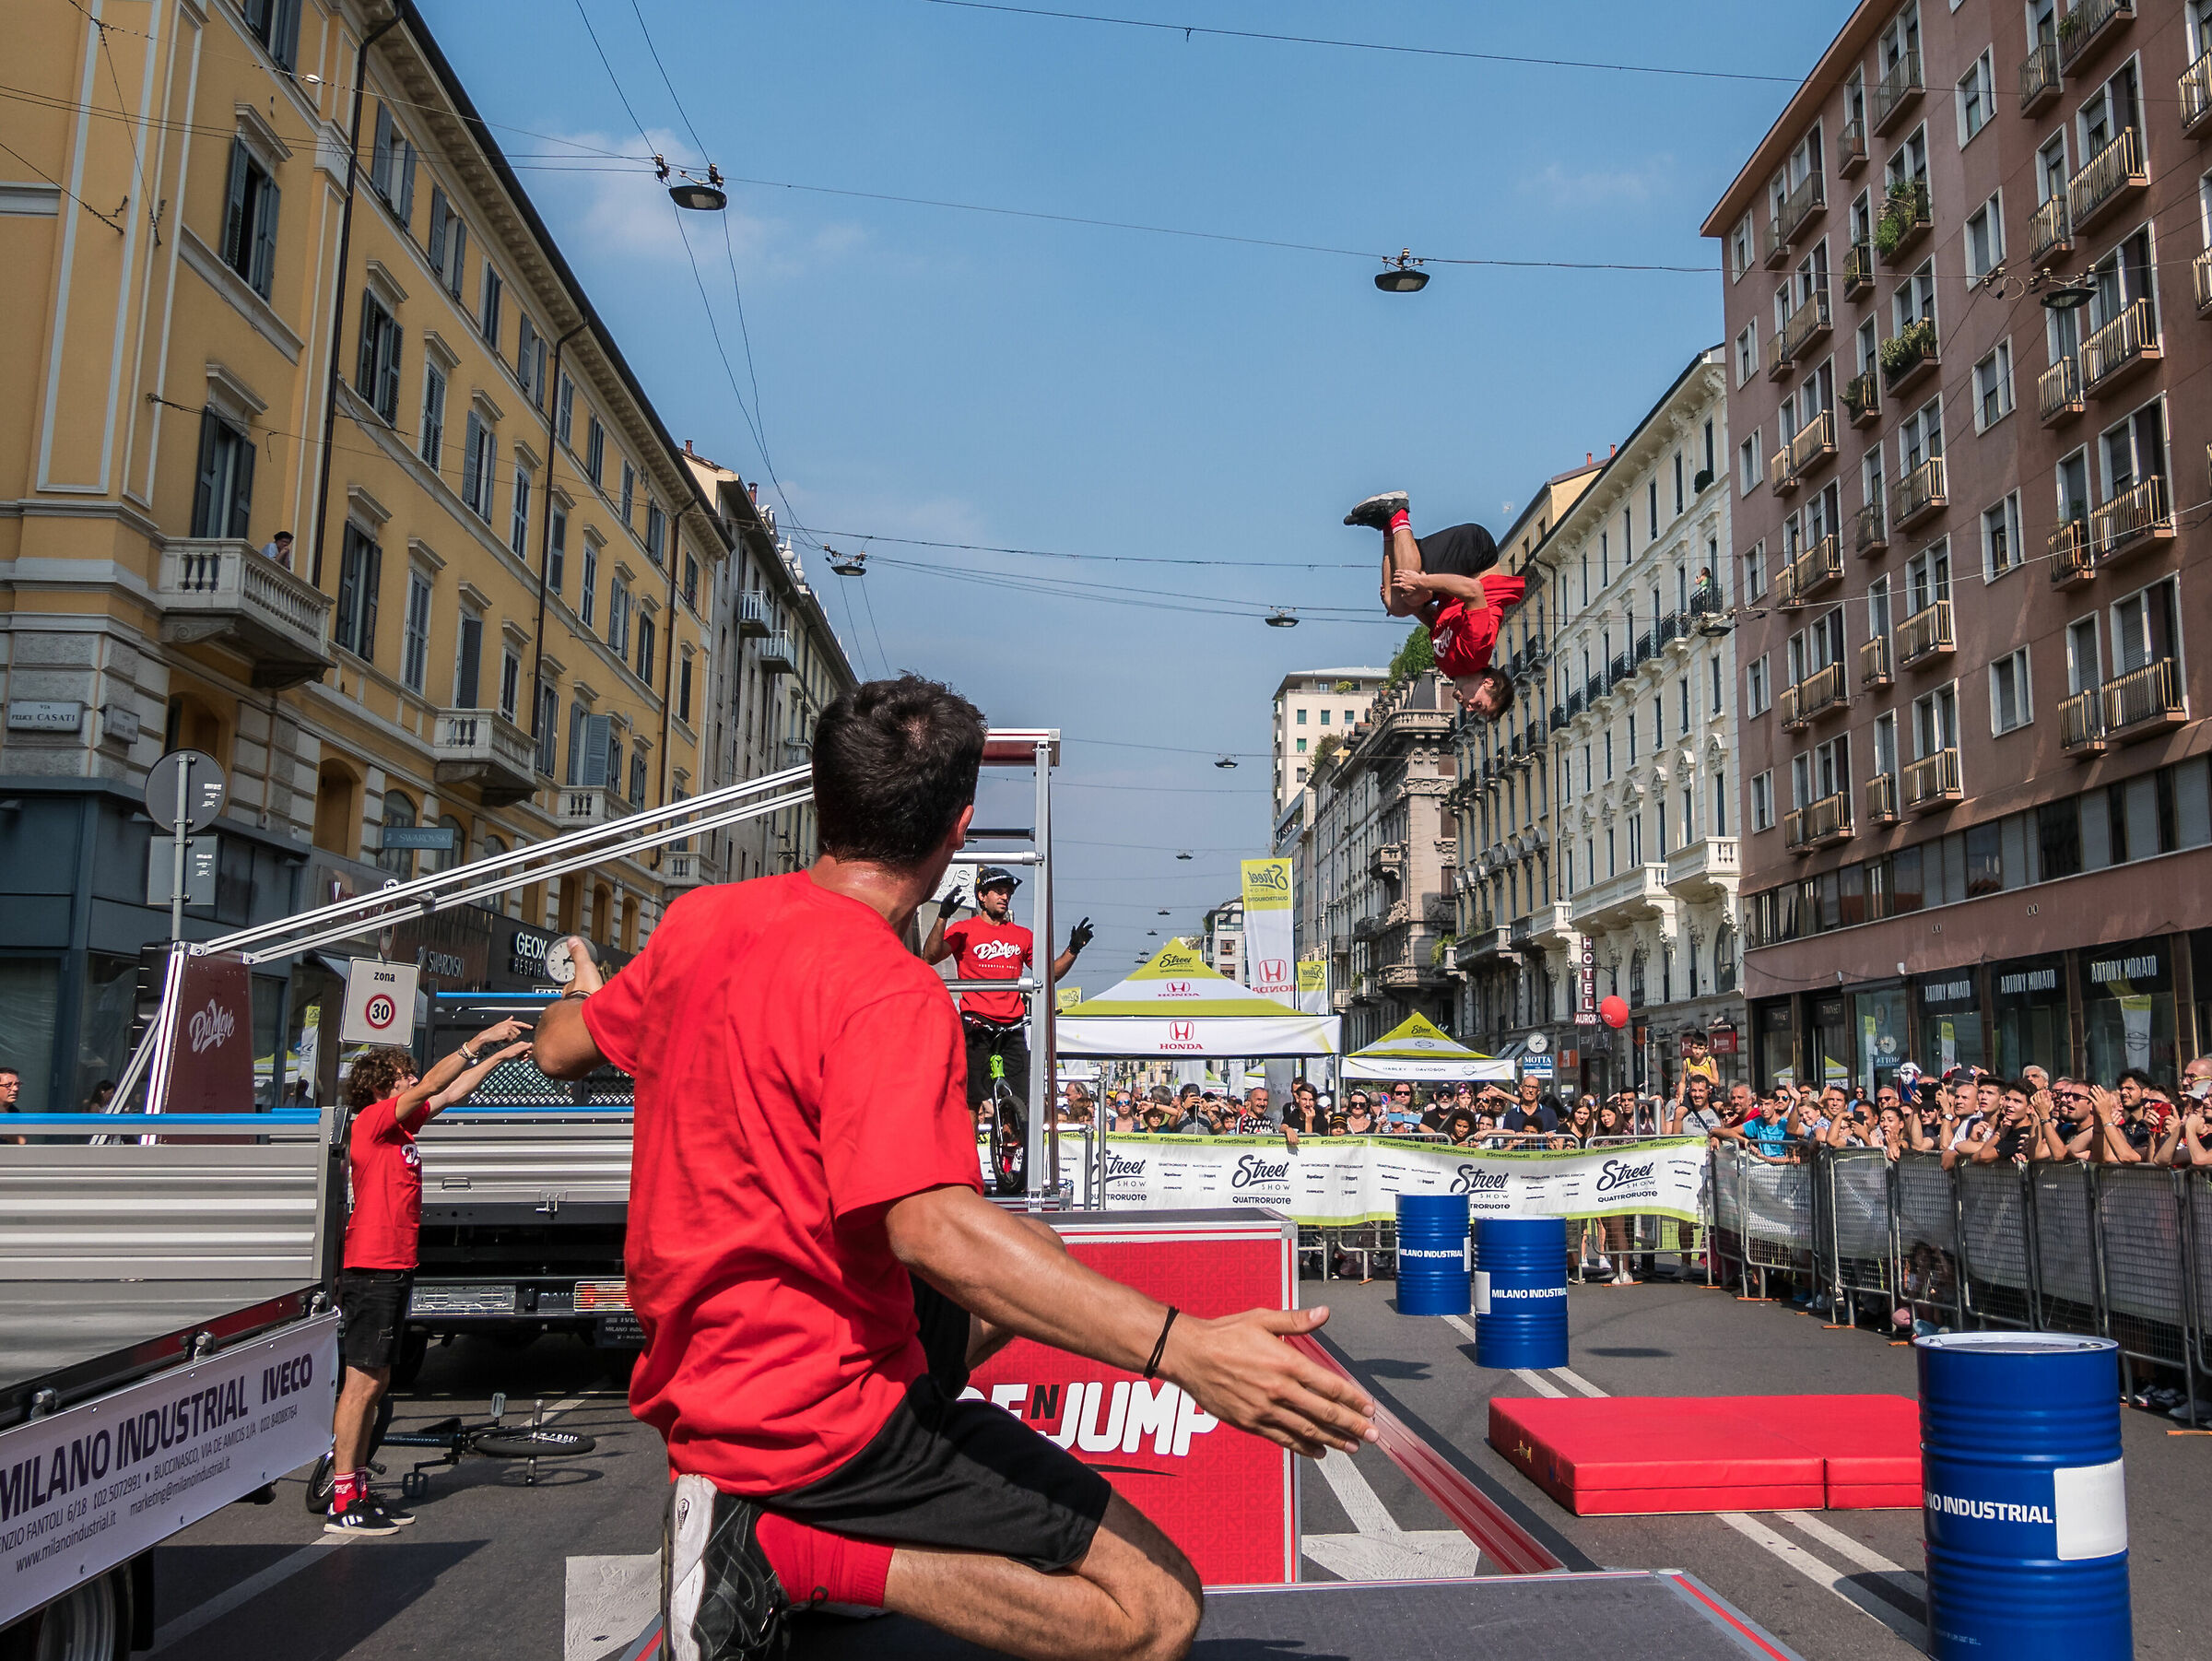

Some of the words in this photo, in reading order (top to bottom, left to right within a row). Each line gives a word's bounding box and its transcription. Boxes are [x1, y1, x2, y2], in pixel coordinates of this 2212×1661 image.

[37, 713, 76, 722] CASATI
[399, 832, 451, 843] SWAROVSKI
[516, 931, 547, 960] GEOX
[428, 950, 465, 979] SWAROVSKI
[1159, 953, 1193, 968] Street
[2124, 954, 2158, 979] MORATO
[374, 971, 395, 983] zona
[1583, 937, 1594, 1010] HOTEL
[2028, 969, 2056, 991] MORATO
[1947, 980, 1971, 999] MORATO
[371, 1003, 390, 1020] 30
[1574, 1014, 1602, 1024] AURORA
[1524, 1055, 1552, 1064] MOTTA
[1379, 1140, 1421, 1149] #StreetShow4R
[1092, 1149, 1147, 1185] Street
[1231, 1154, 1290, 1188] Street
[1596, 1159, 1654, 1192] Street
[1450, 1163, 1510, 1194] Street
[1627, 1180, 1656, 1189] SHOW
[1399, 1248, 1423, 1258] MILANO
[1424, 1249, 1464, 1258] INDUSTRIAL
[1491, 1289, 1528, 1299] MILANO
[0, 1429, 111, 1523] MILANO
[116, 1375, 248, 1471] INDUSTRIAL
[262, 1353, 313, 1405] IVECO
[0, 1526, 24, 1554] NZIO
[27, 1508, 63, 1541] FANTOLI
[67, 1498, 87, 1524] 6/18
[109, 1473, 141, 1502] 5072991
[201, 1442, 212, 1459] VIA
[213, 1438, 222, 1454] DE
[17, 1510, 116, 1573] www.milanoindustrial.it
[130, 1455, 230, 1516] marketing@milanoindustrial.it
[1943, 1495, 2053, 1524] INDUSTRIAL
